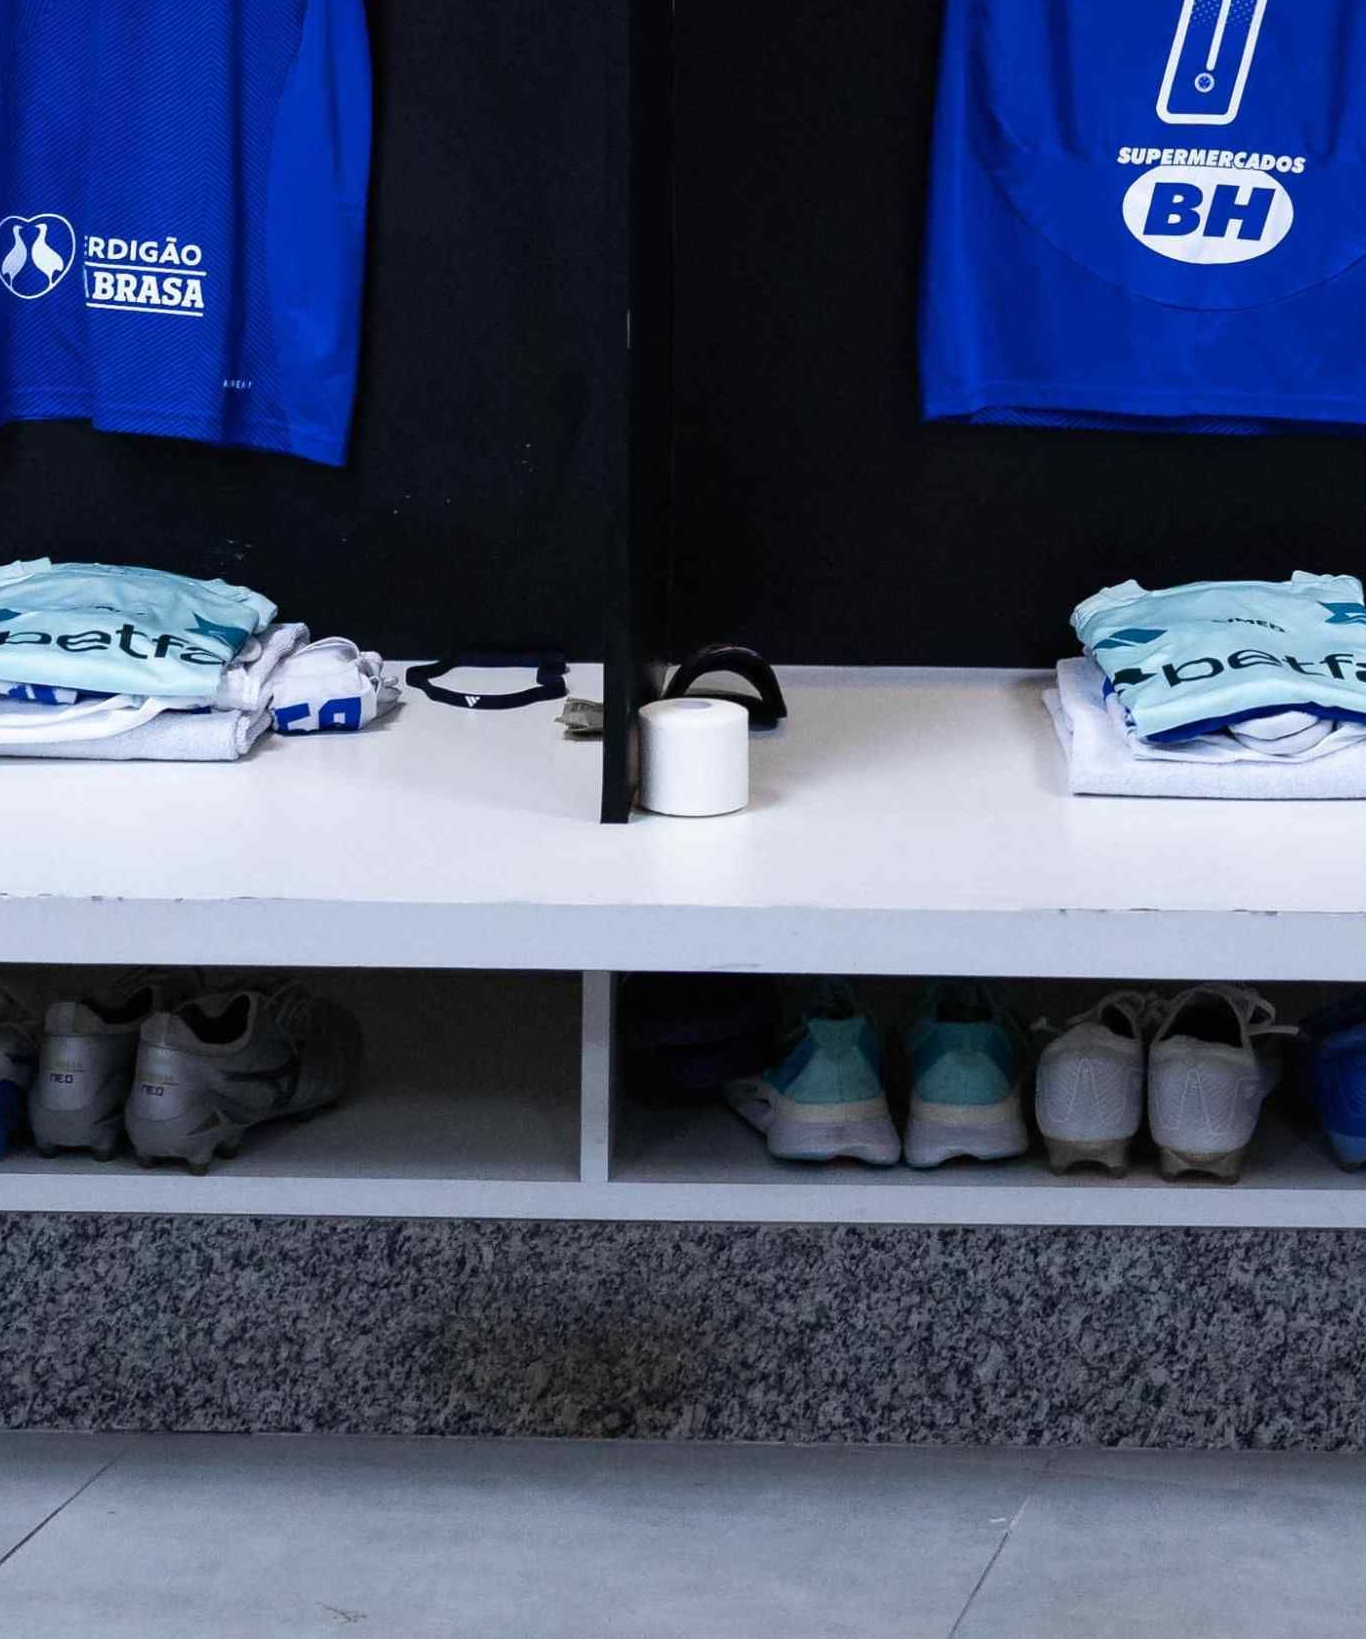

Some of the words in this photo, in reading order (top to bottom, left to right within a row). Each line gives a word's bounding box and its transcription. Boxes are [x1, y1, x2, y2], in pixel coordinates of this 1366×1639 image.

[1117, 146, 1306, 174] SUPERMERCADOS
[1143, 181, 1276, 242] BH
[85, 235, 202, 266] RDIGÃO
